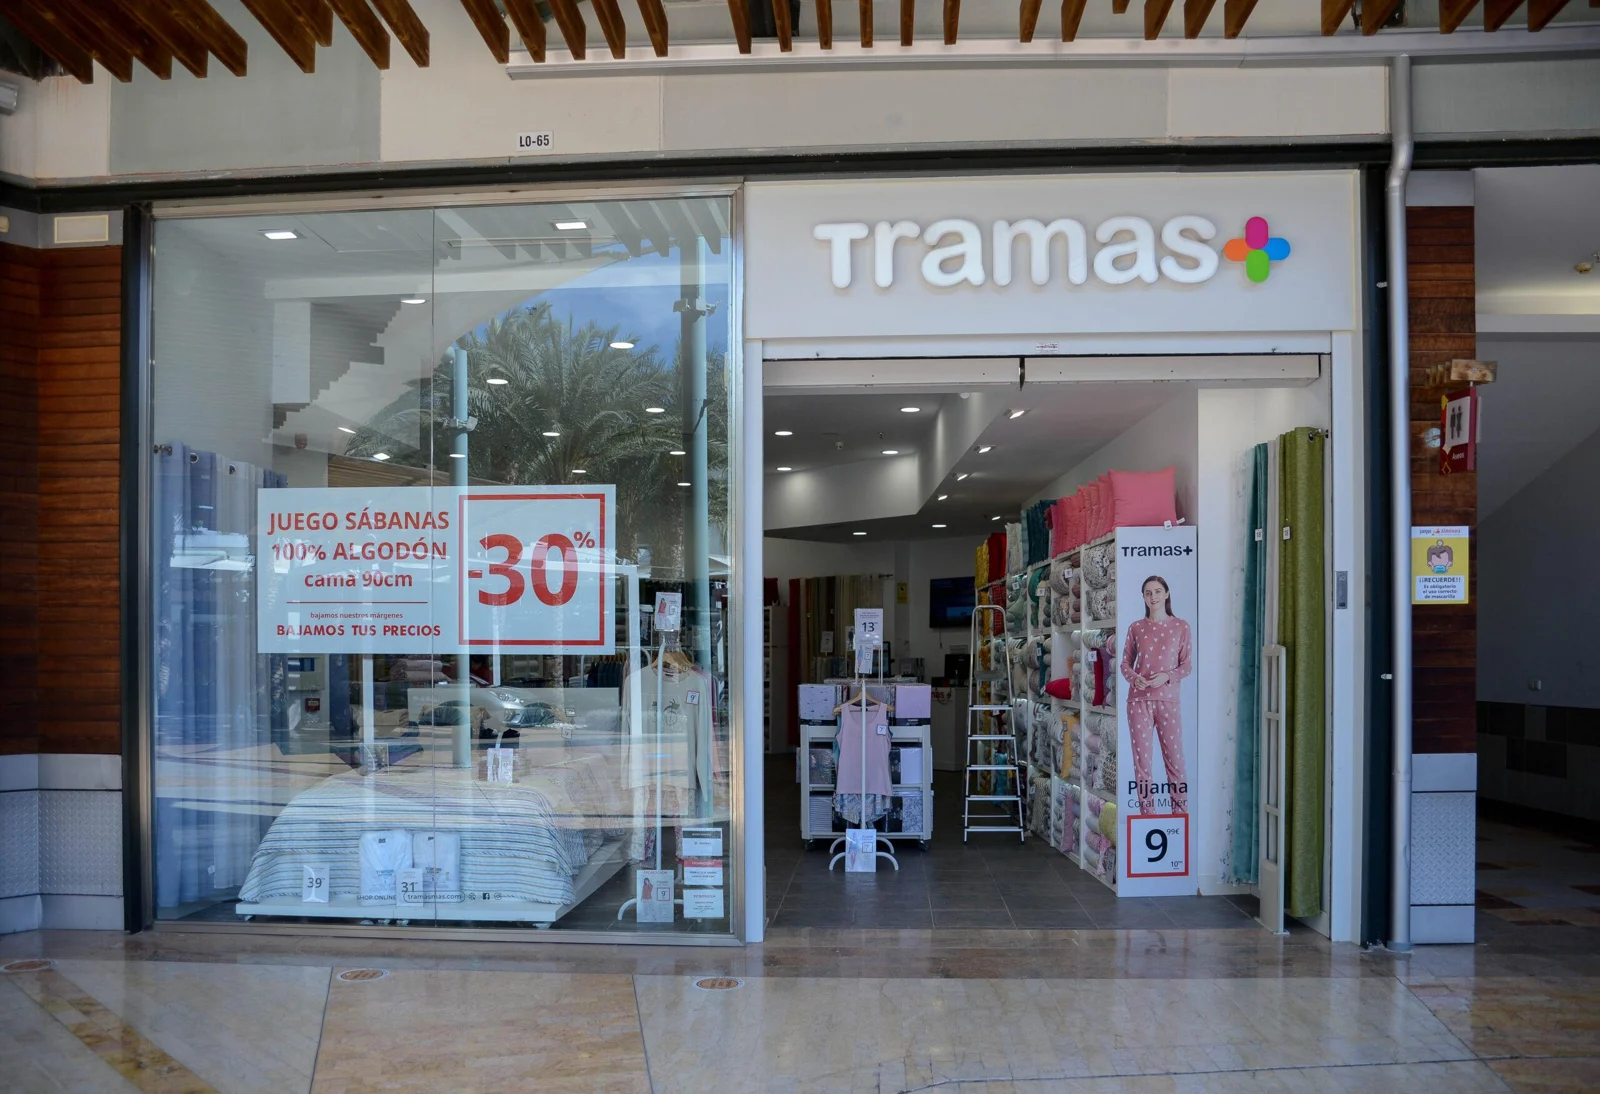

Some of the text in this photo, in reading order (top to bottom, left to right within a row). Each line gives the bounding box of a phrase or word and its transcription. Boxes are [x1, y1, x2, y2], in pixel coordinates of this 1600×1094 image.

[519, 134, 550, 147] LO-65
[1452, 452, 1465, 460] Aseos
[267, 507, 450, 535] JUEGO SÁBANAS
[272, 537, 447, 561] 100% ALGODÓN
[304, 570, 413, 588] cama 90cm
[310, 612, 338, 620] bajamos
[370, 612, 404, 620] márgenes
[276, 624, 441, 636] BAJAMOS TUS PRECIOS
[1128, 780, 1188, 799] Pijama
[1127, 798, 1188, 809] Coral Mujer
